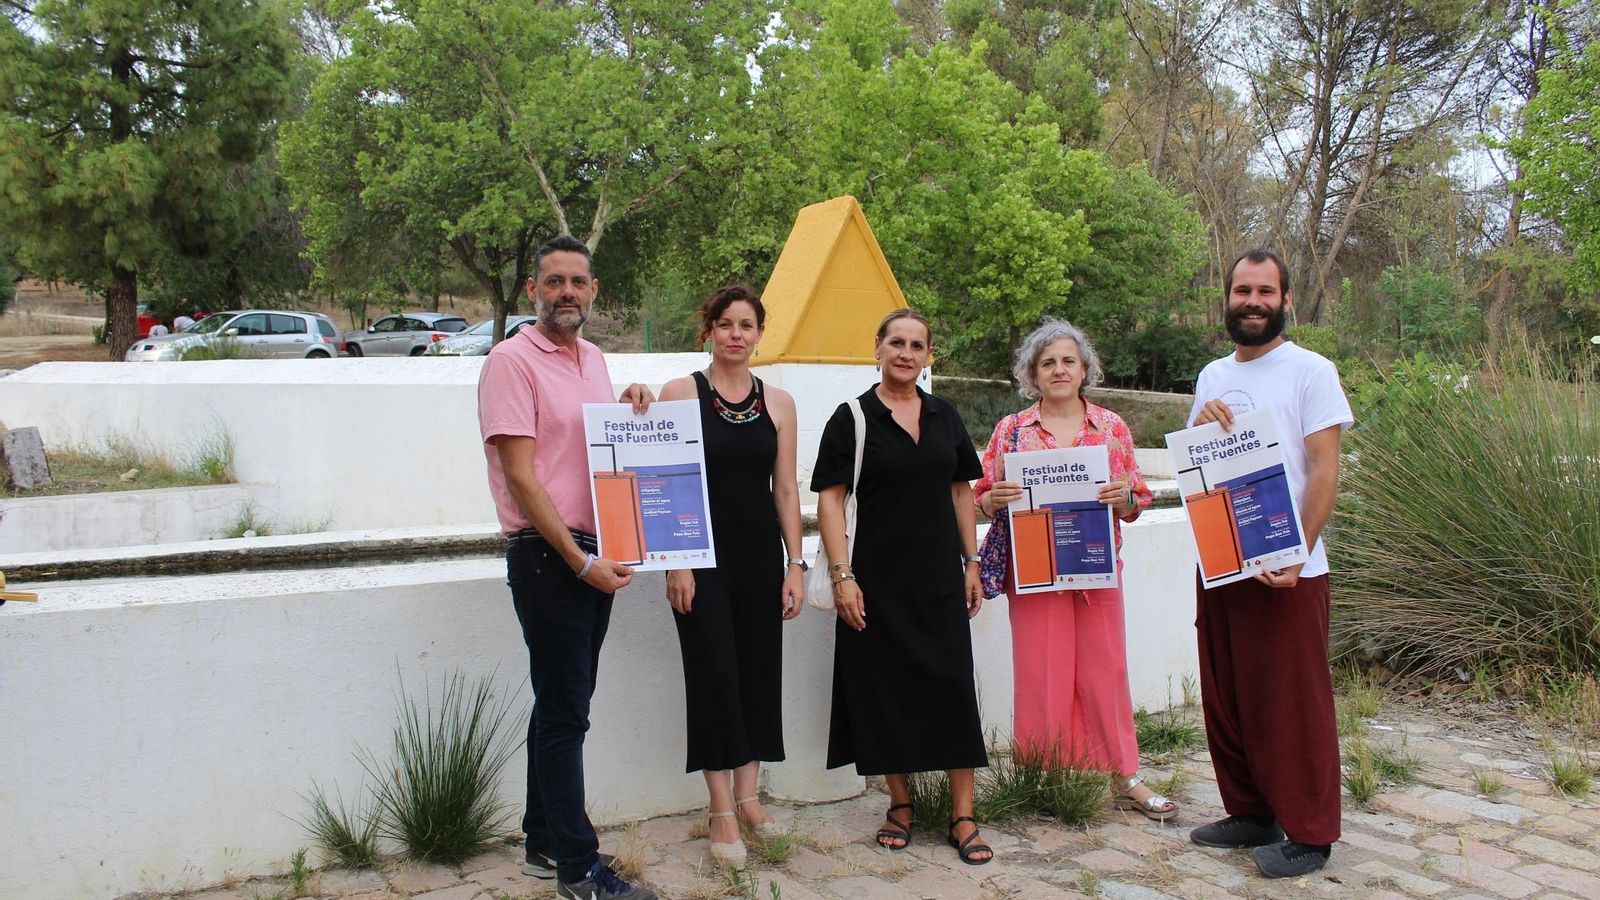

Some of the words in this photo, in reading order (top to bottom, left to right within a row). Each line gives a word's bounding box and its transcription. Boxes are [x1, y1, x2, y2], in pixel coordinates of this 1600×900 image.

[604, 420, 654, 431] Festival
[657, 420, 674, 430] de
[606, 433, 624, 443] las
[627, 432, 679, 443] Fuentes
[1188, 434, 1238, 455] Festival
[1240, 430, 1255, 441] de
[1190, 455, 1210, 466] las
[1212, 439, 1261, 461] Fuentes
[1022, 464, 1068, 476] Festival
[1071, 463, 1086, 472] de
[1023, 477, 1040, 486] las
[1043, 473, 1089, 484] Fuentes
